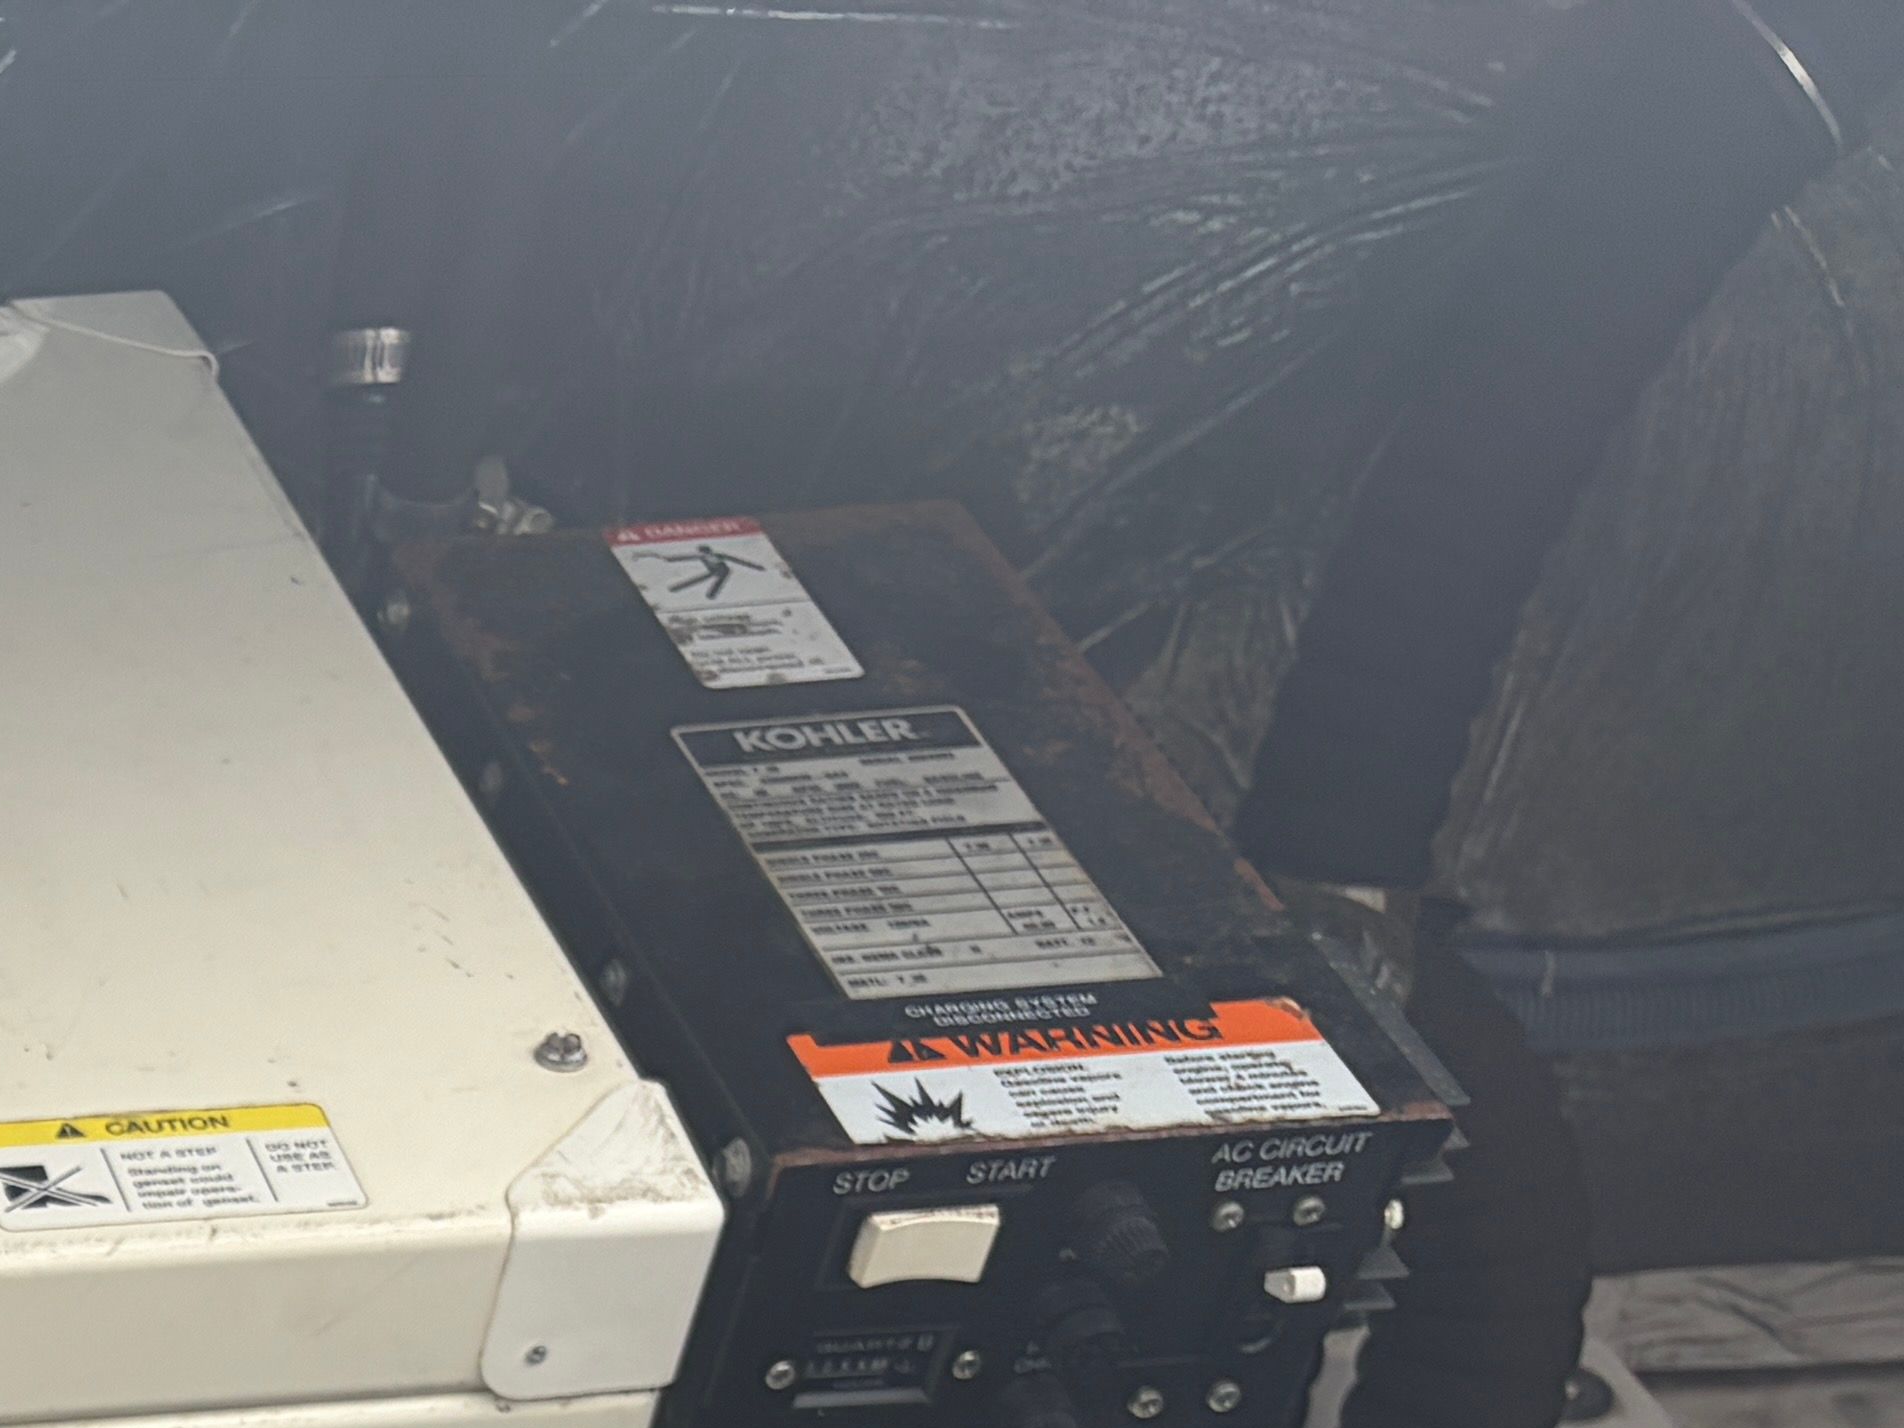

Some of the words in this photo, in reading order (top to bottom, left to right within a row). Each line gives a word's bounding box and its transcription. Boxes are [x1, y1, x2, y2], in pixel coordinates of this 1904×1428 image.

[733, 718, 919, 753] KOHLER
[904, 999, 1013, 1020] CHARGING
[1014, 993, 1097, 1012] SYSTEM
[932, 1006, 1092, 1028] DISCONNECTED
[948, 1017, 1225, 1060] WARNING
[102, 1115, 232, 1135] CAUTION
[119, 1150, 153, 1161] NOT
[158, 1149, 171, 1158] A
[174, 1146, 219, 1158] STEP
[292, 1139, 328, 1149] NOT
[1210, 1141, 1254, 1166] AC
[1257, 1132, 1371, 1162] CIRCUIT
[126, 1164, 198, 1177] Standing
[131, 1177, 186, 1188] genset
[189, 1173, 234, 1183] could
[832, 1167, 911, 1195] STOP
[965, 1155, 1056, 1184] START
[1214, 1161, 1344, 1193] BREAKER
